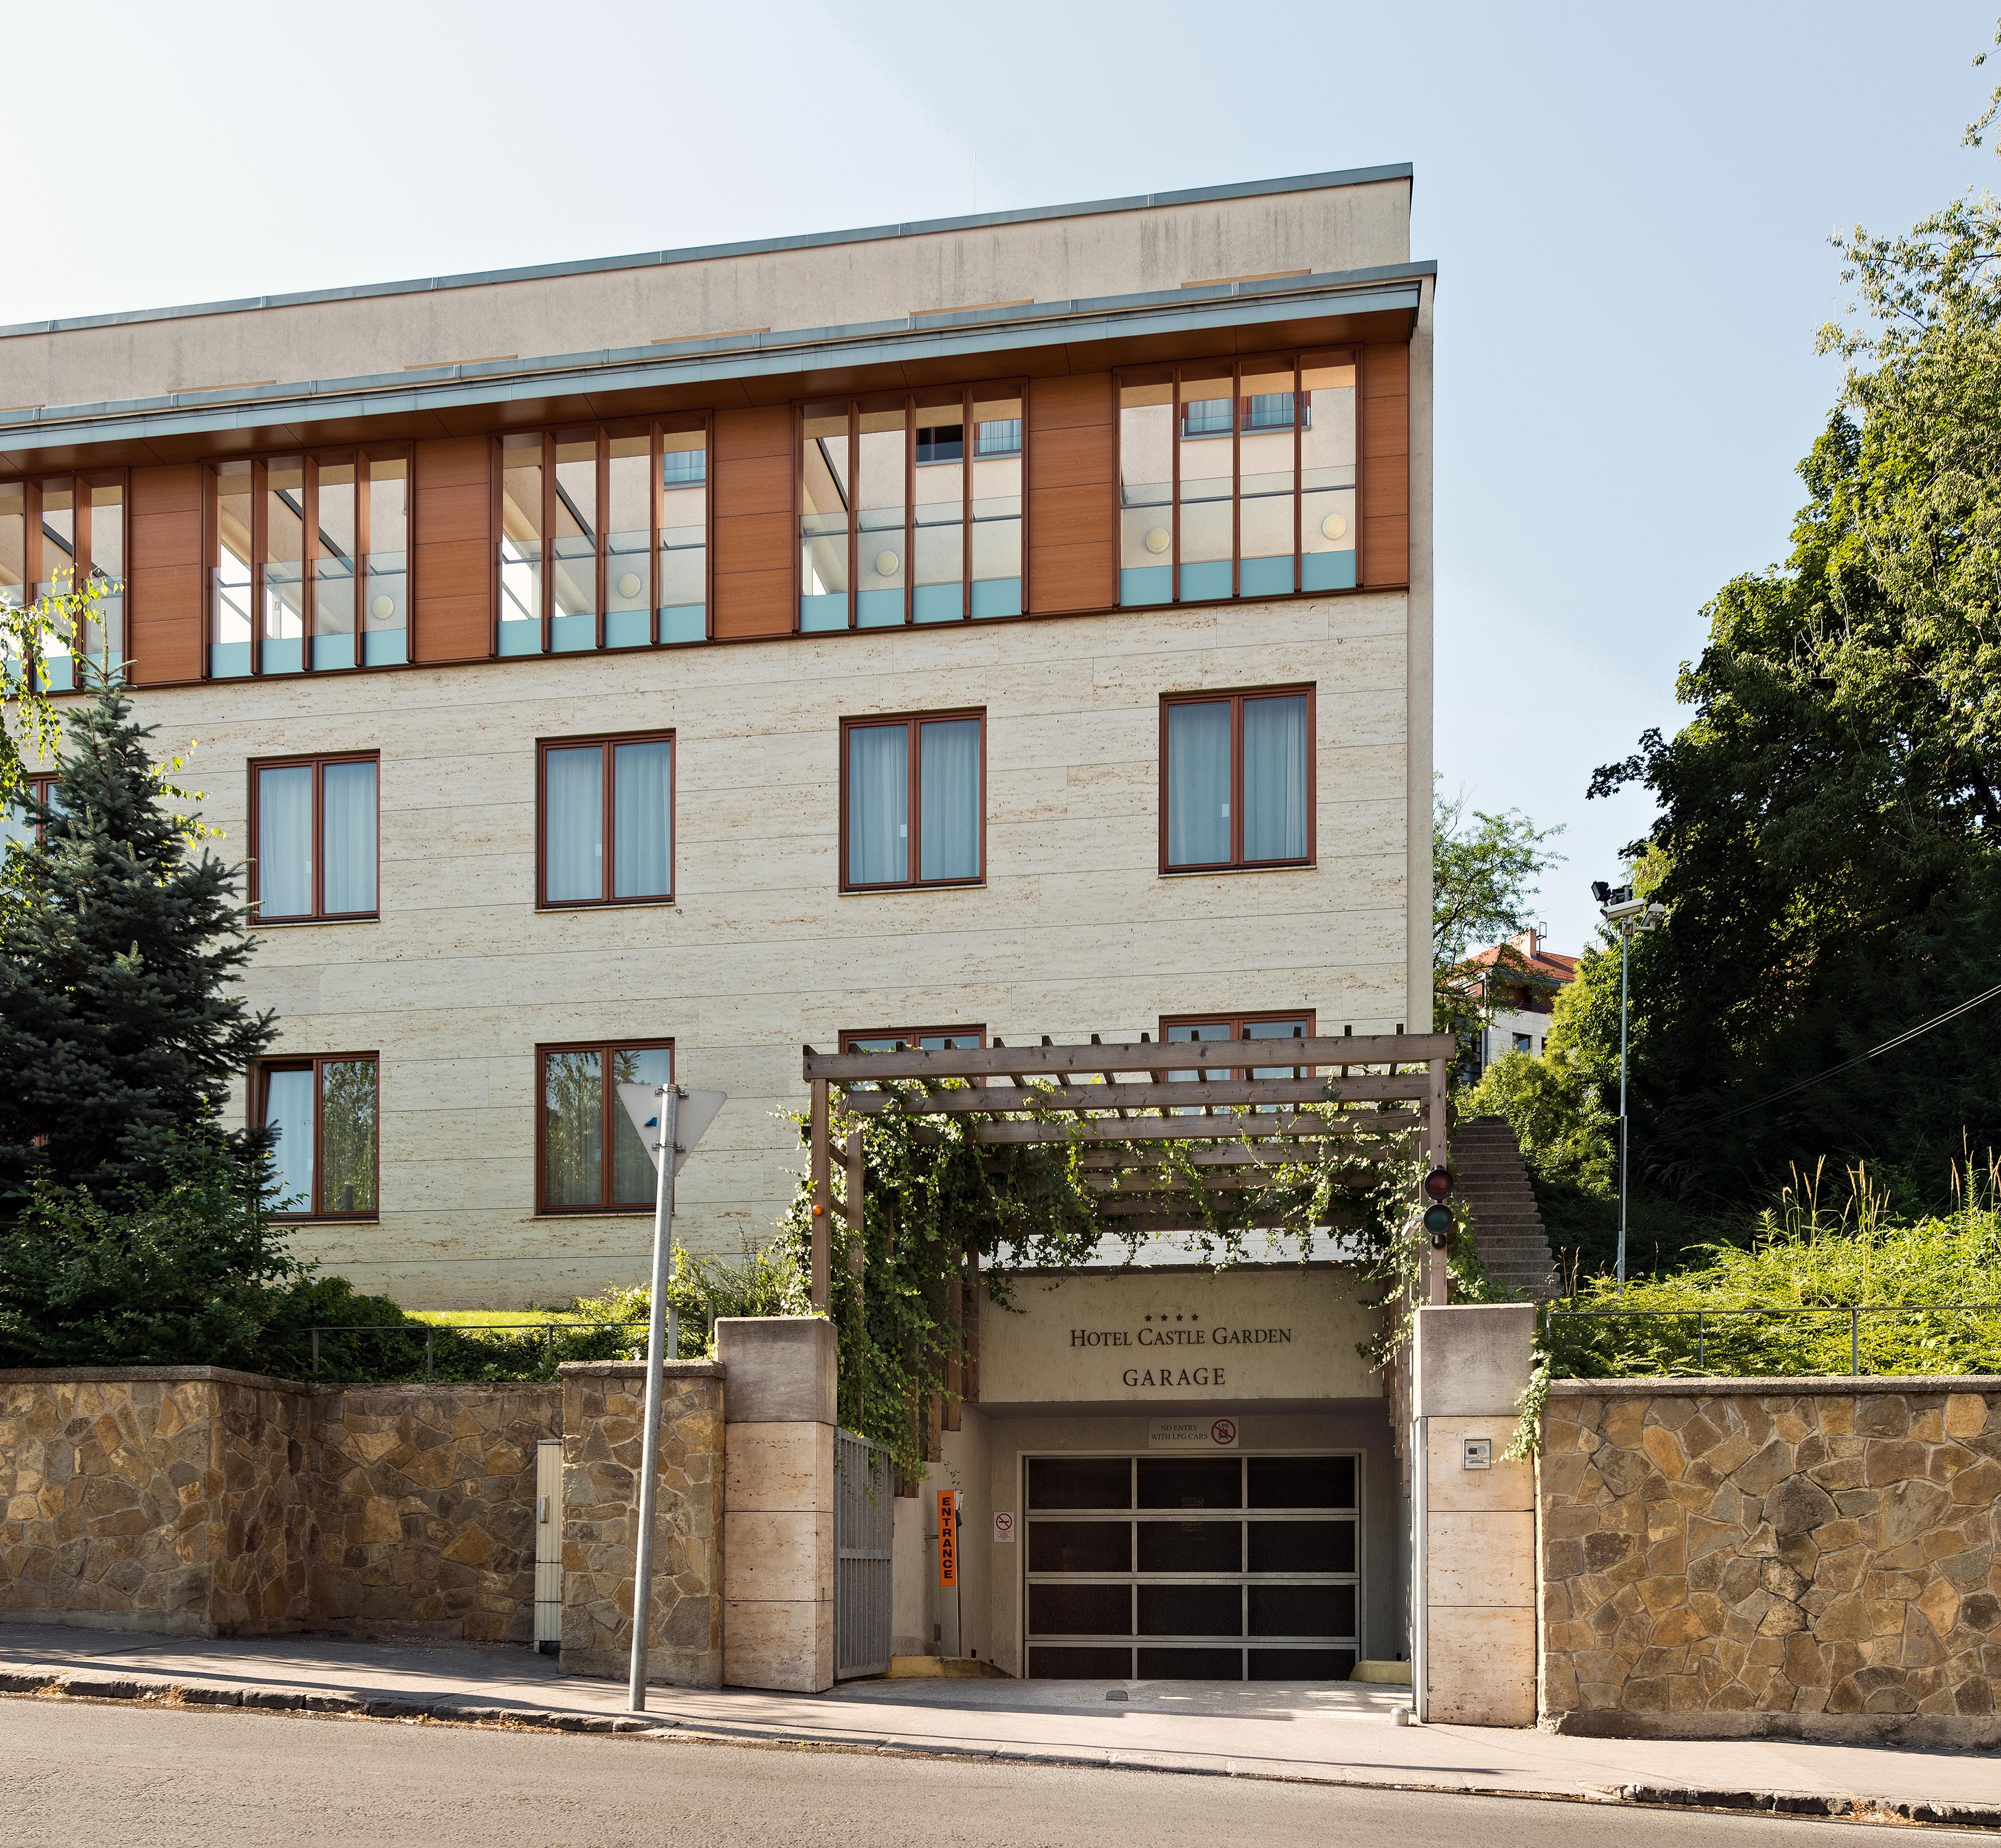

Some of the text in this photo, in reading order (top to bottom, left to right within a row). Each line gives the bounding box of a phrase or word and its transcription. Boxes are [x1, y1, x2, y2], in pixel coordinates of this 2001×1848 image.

[1071, 1327, 1292, 1346] HOTEL CASTLE GARDEN
[1123, 1368, 1226, 1386] GARAGE
[941, 1497, 953, 1579] ENTRANCE
